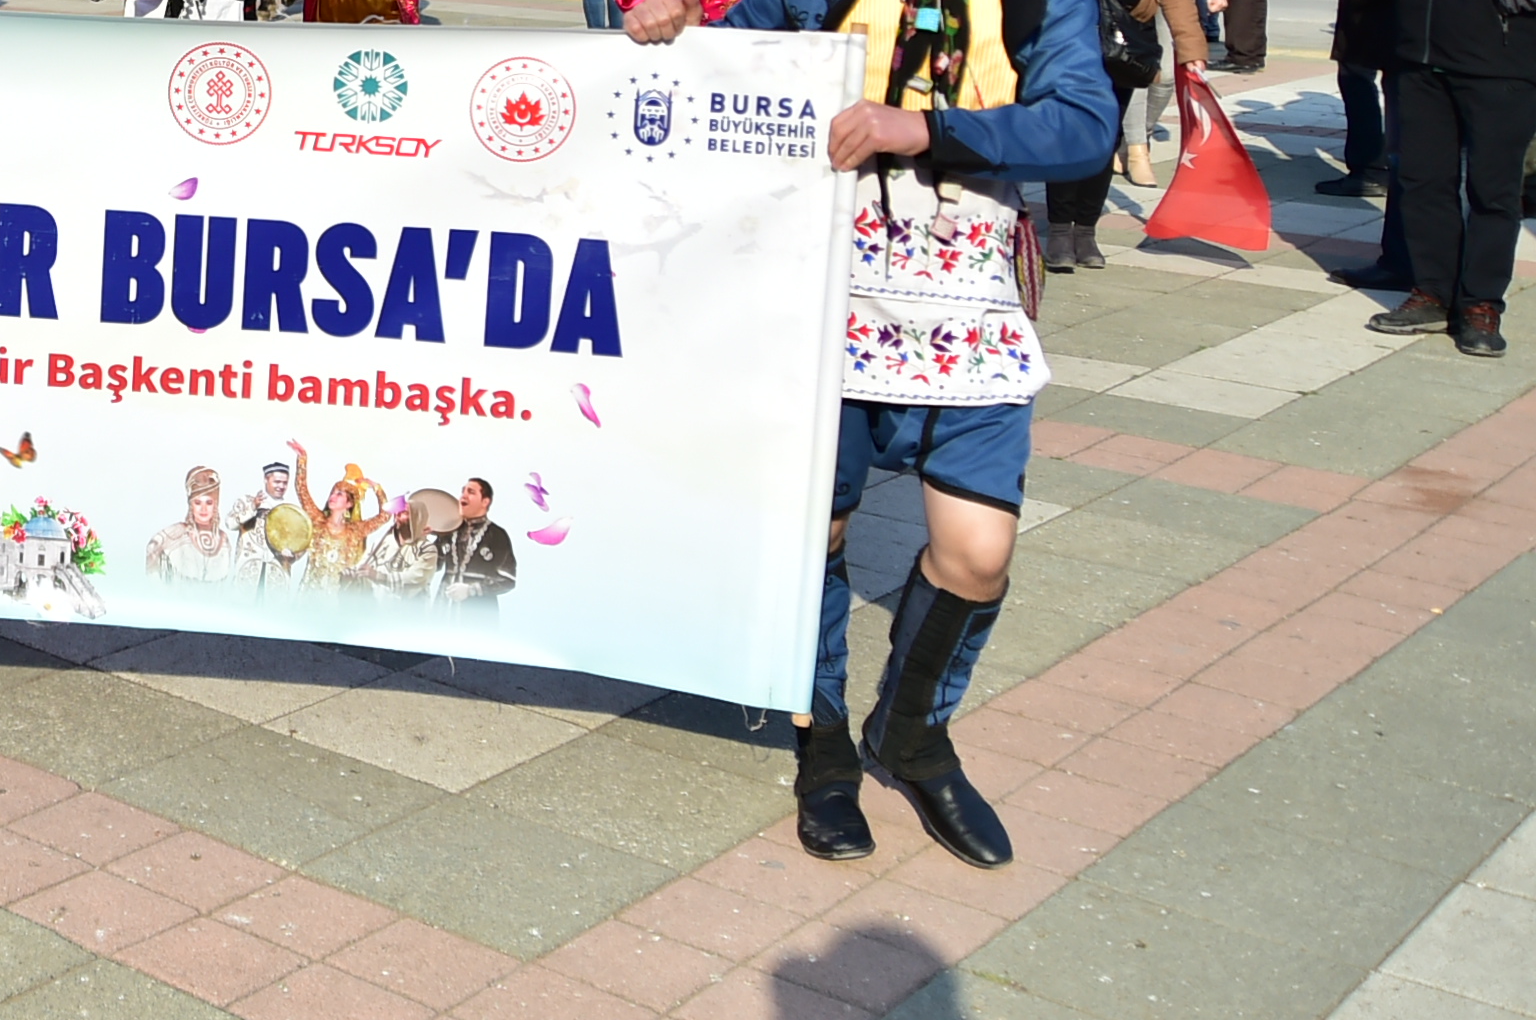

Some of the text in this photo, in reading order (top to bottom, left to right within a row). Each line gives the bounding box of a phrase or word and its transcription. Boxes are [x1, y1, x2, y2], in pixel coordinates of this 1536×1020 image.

[710, 92, 817, 120] BURSA
[708, 116, 816, 140] BÜYÜKŞEHİR
[707, 136, 816, 159] BELEDİYESİ
[100, 209, 623, 358] BURSA'DA
[47, 353, 254, 403] Başkenti
[268, 363, 532, 427] bambaşka.
